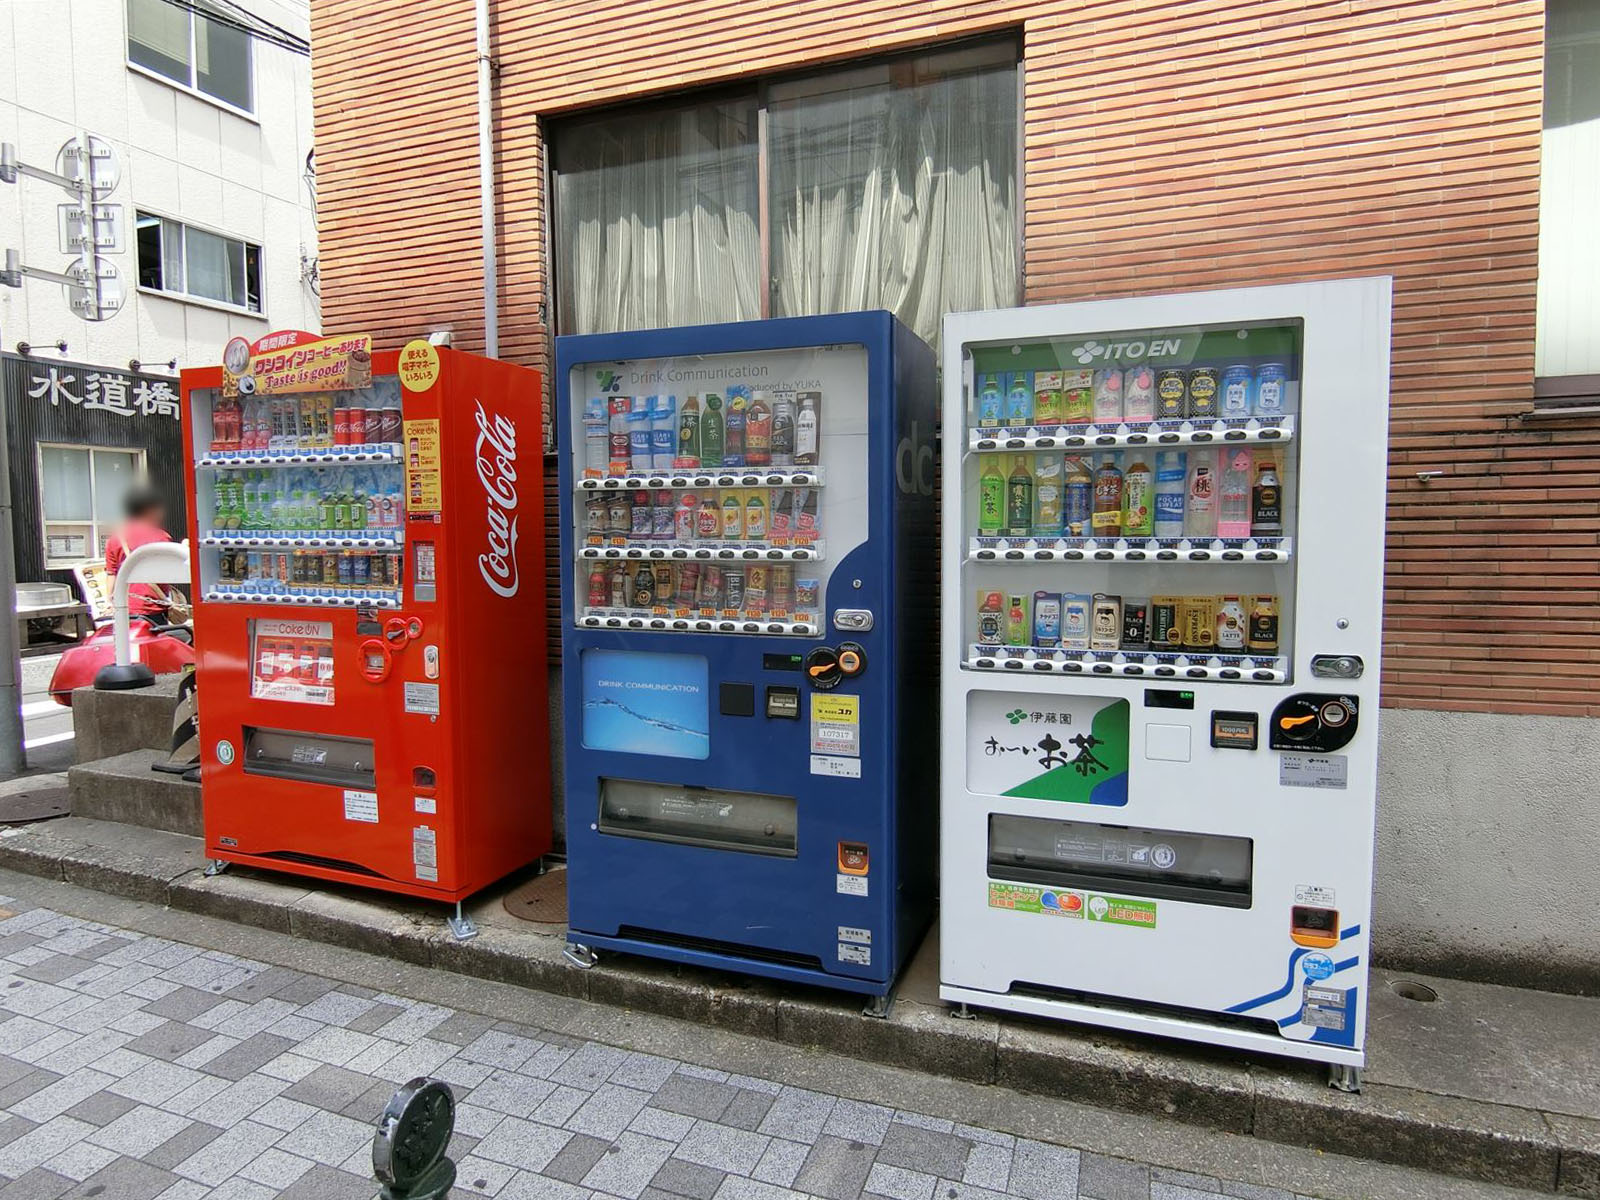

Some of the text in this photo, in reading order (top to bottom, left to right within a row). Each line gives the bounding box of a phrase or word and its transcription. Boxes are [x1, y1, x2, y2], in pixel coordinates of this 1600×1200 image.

[1104, 339, 1181, 360] ITO EN
[266, 374, 296, 388] Taste
[299, 369, 308, 379] is
[631, 364, 768, 385] Drink Communication
[28, 368, 180, 420] 水道橋
[1196, 477, 1209, 492] 桃
[475, 398, 519, 598] Coca-Cola
[279, 623, 304, 635] Coke
[598, 680, 699, 692] DRINK COMMUNICATION
[1029, 711, 1072, 724] 伊藤園
[1108, 907, 1155, 923] LED照明
